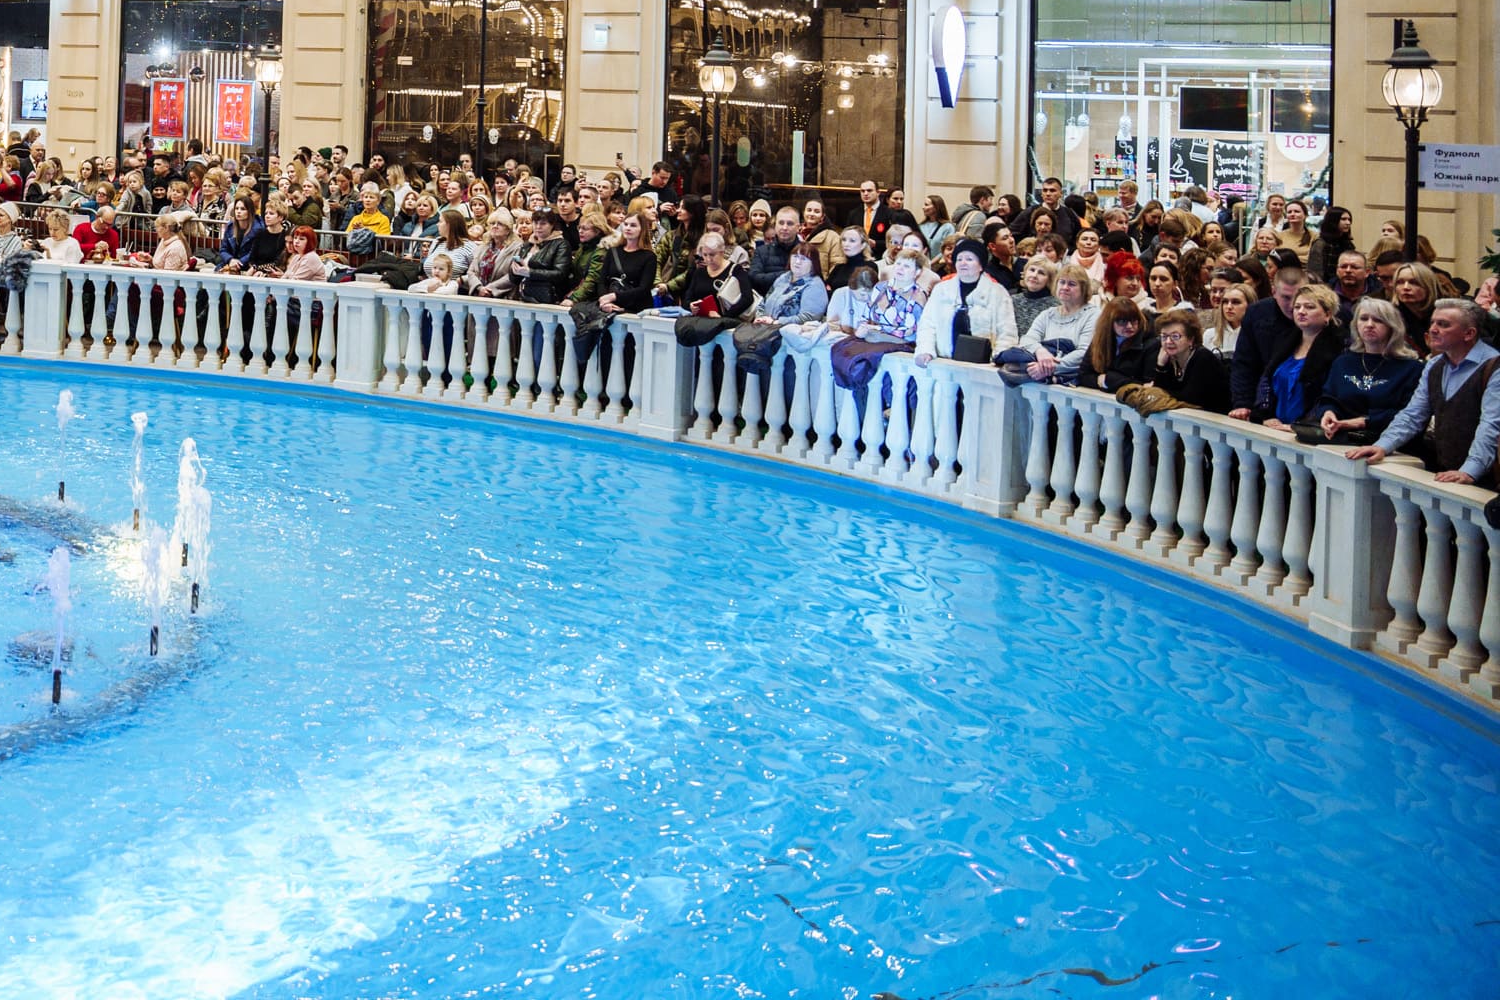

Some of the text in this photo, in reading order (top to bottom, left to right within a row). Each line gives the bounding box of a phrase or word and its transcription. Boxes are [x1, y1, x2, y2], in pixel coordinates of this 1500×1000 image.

[1285, 135, 1317, 149] ICE
[1434, 149, 1480, 158] Фудмолл
[1434, 172, 1473, 180] Южный
